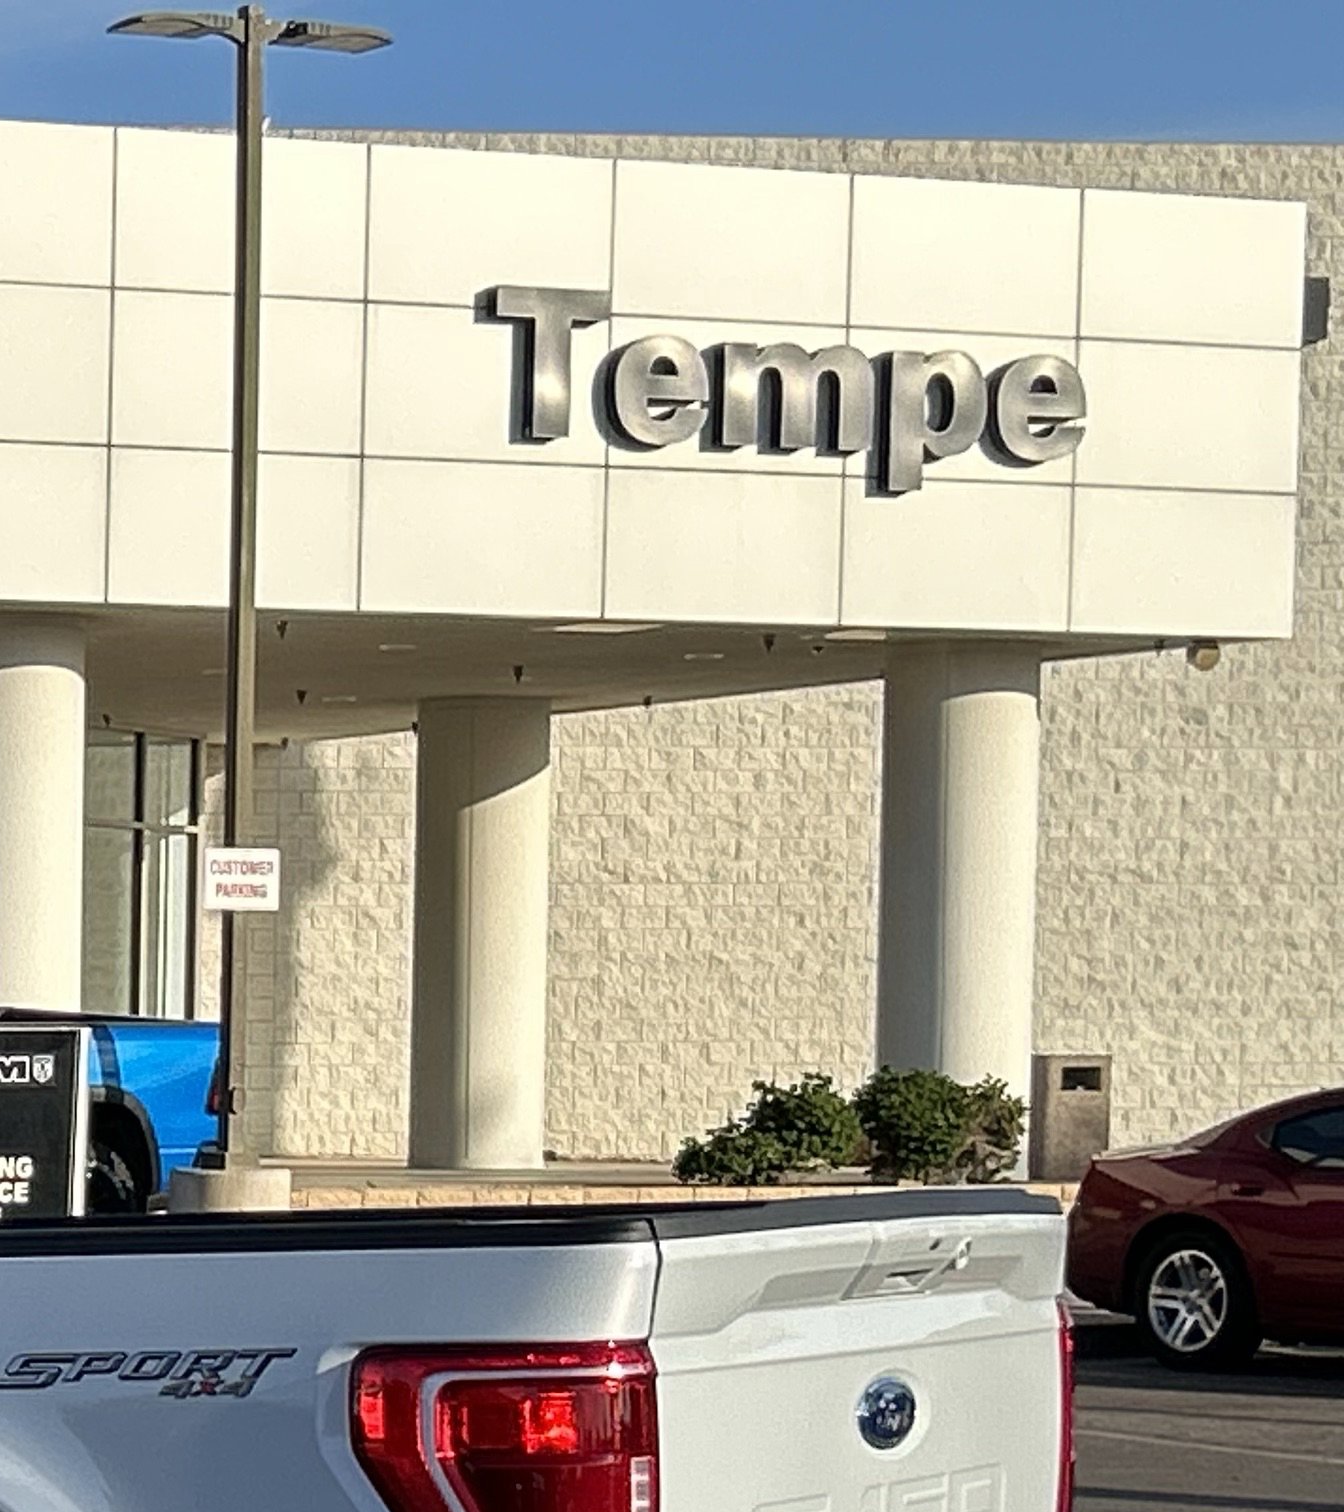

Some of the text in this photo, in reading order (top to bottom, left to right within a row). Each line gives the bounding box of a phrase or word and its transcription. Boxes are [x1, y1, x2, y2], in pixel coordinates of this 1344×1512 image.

[474, 285, 1086, 498] Tempe
[210, 860, 273, 875] CUSTOMER
[216, 883, 268, 898] PARKING
